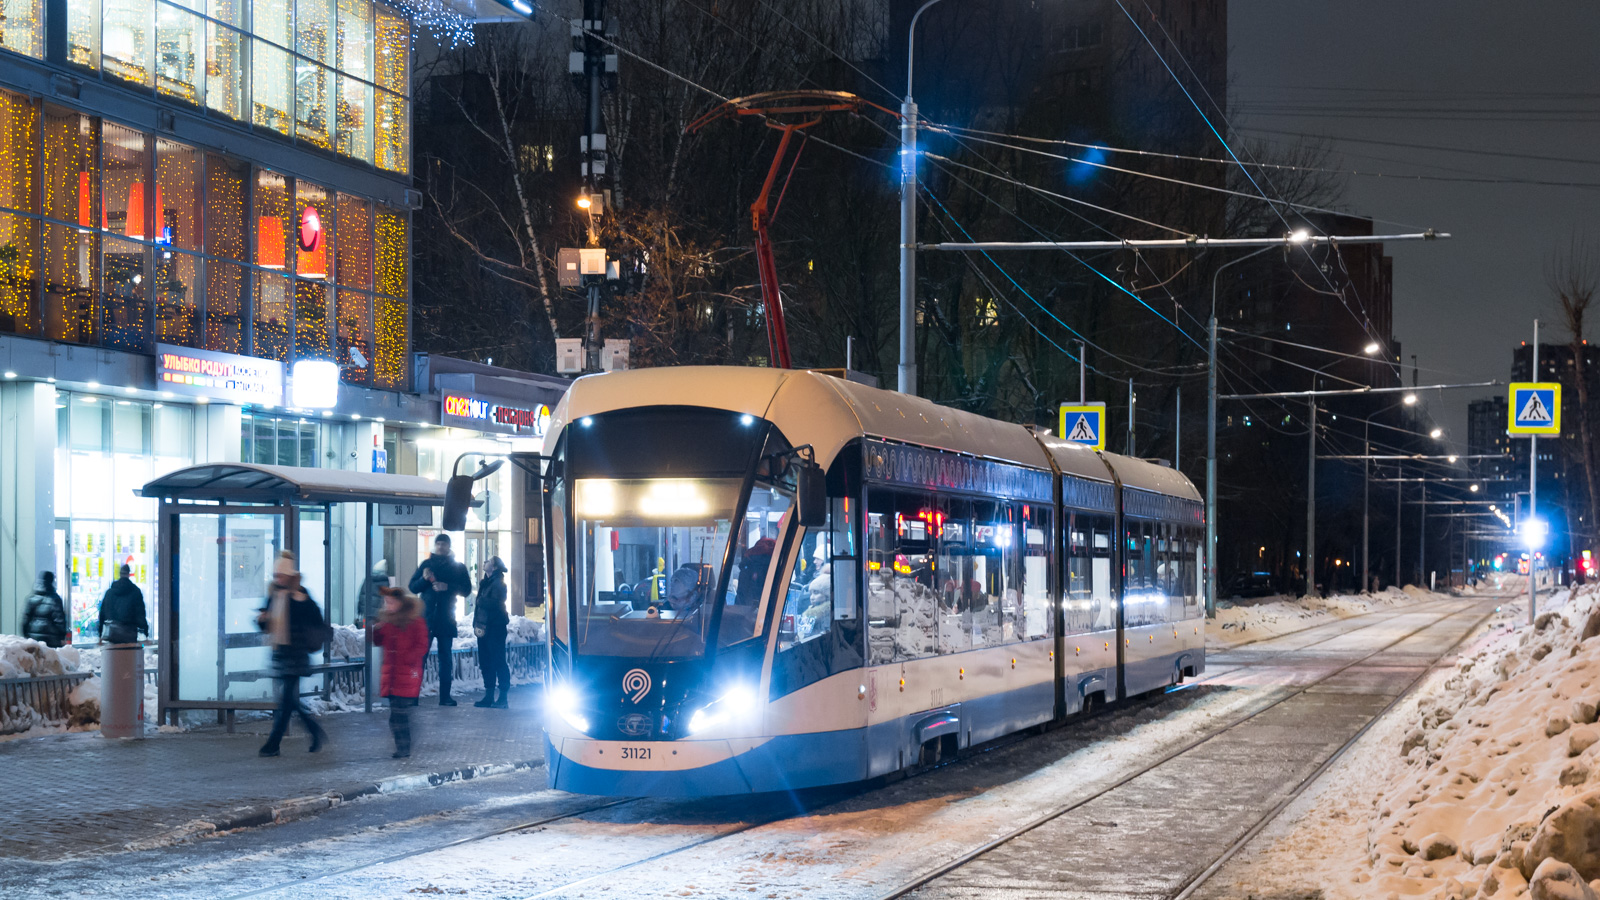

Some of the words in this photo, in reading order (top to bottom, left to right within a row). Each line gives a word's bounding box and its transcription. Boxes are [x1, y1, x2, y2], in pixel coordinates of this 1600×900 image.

[394, 505, 403, 515] 36
[406, 505, 414, 515] 37
[621, 747, 652, 760] 31121
